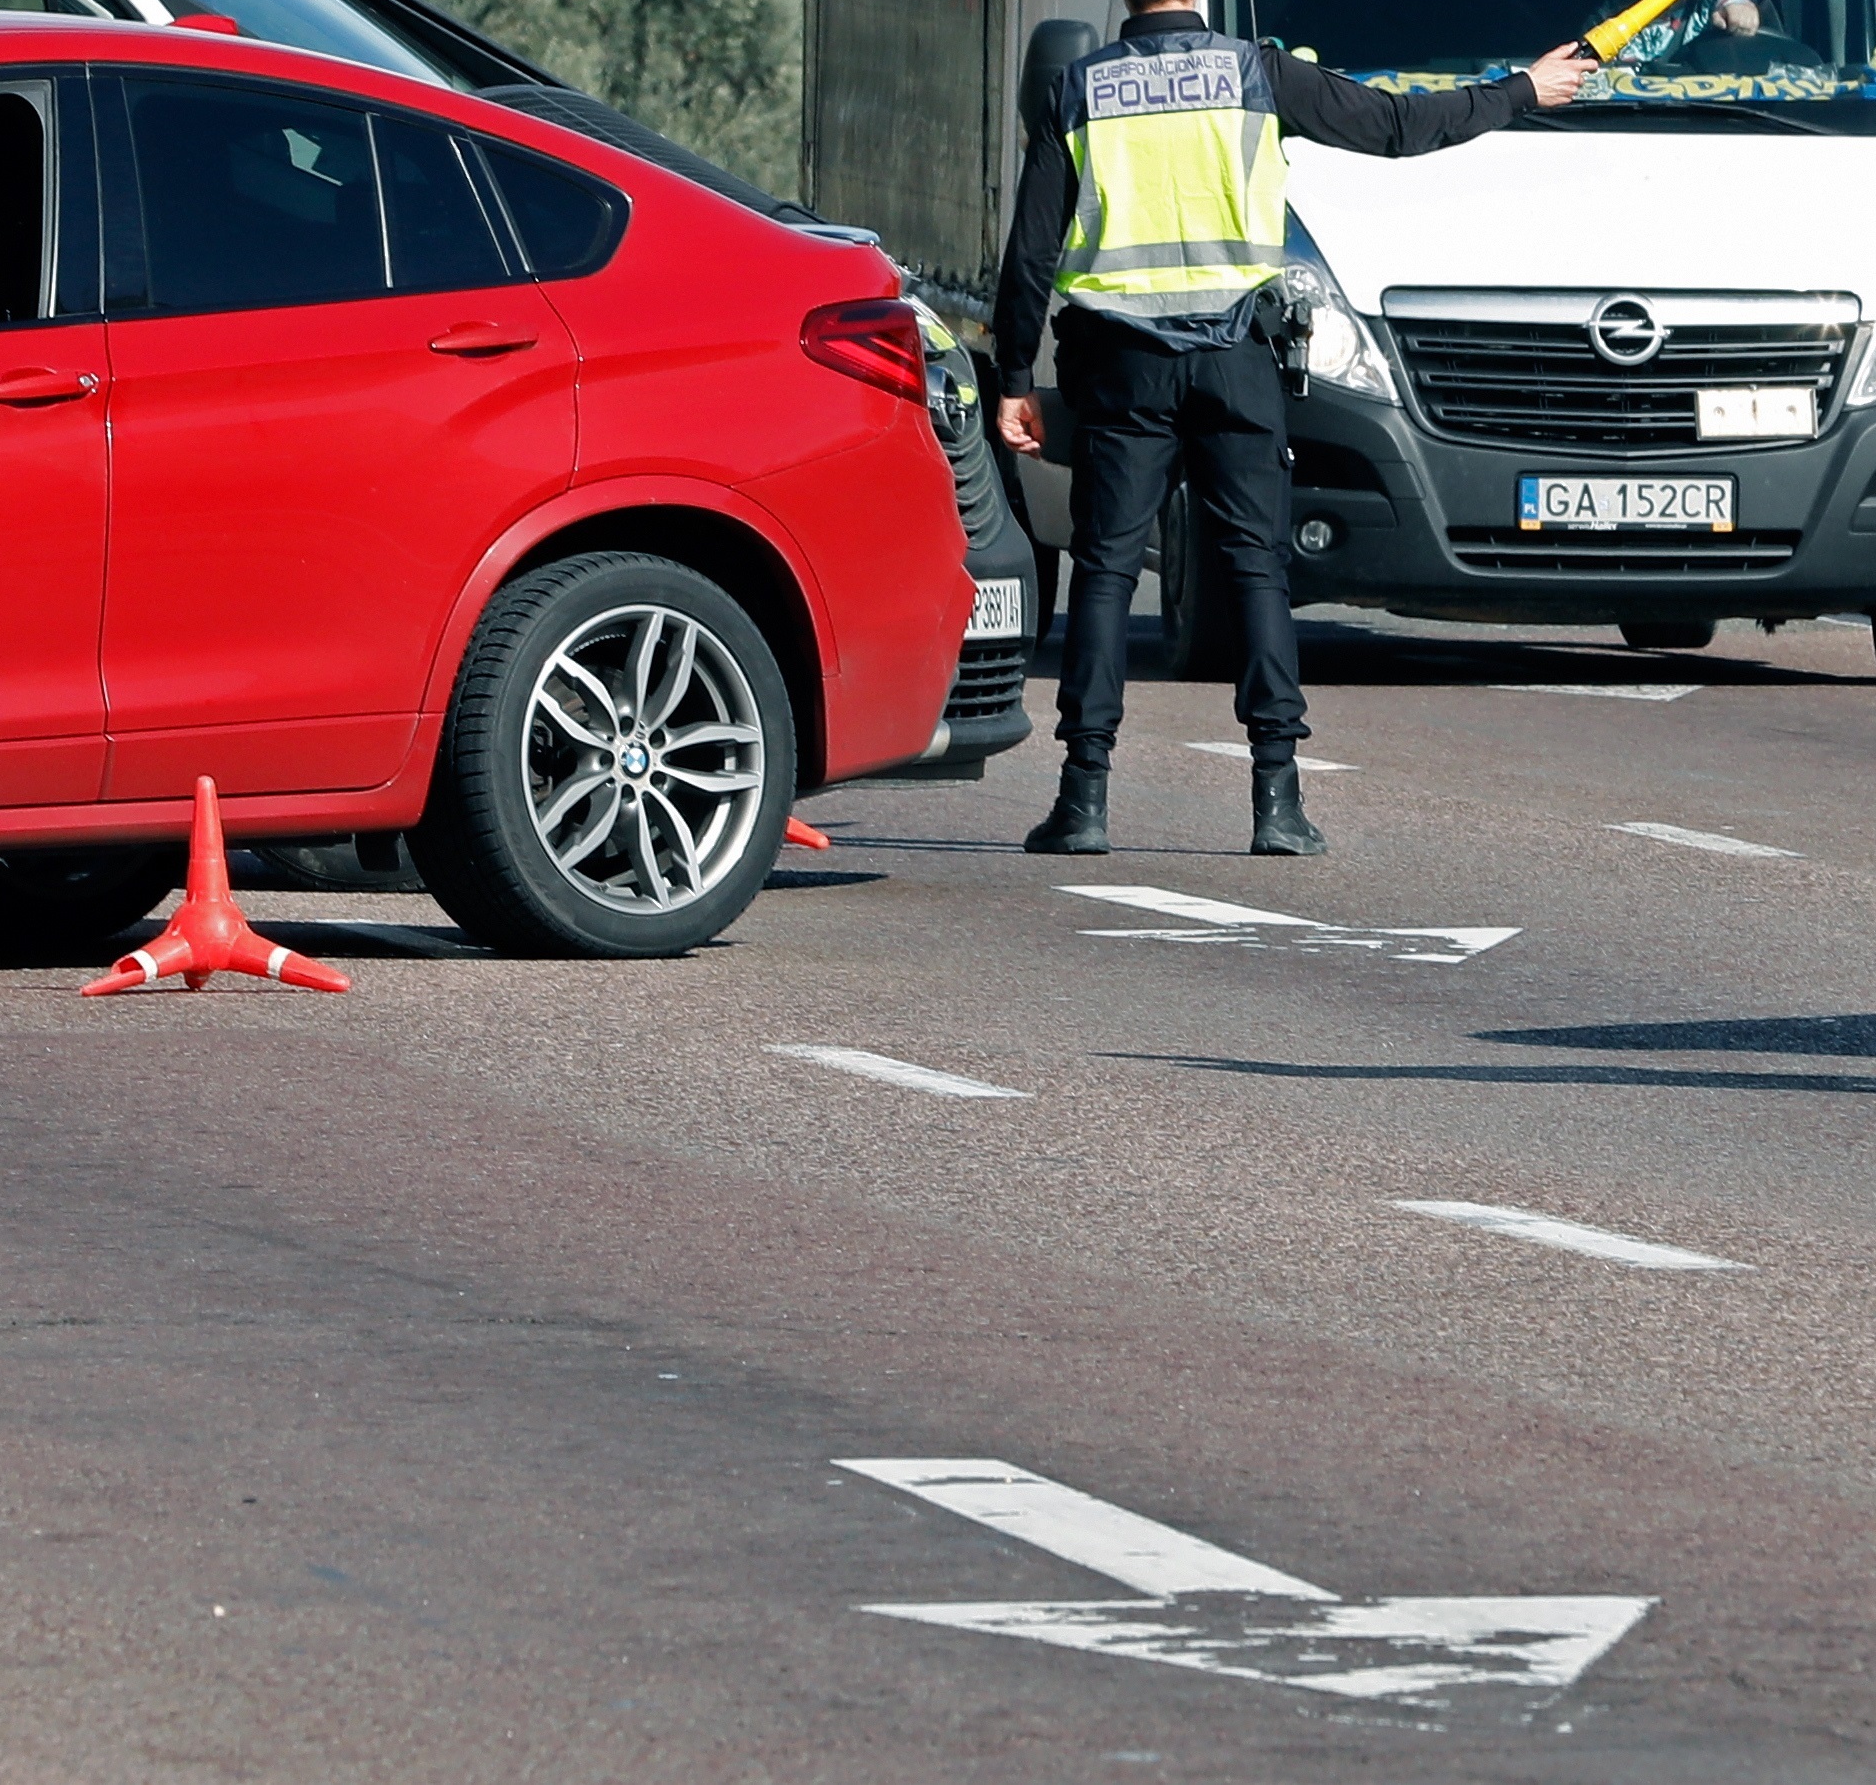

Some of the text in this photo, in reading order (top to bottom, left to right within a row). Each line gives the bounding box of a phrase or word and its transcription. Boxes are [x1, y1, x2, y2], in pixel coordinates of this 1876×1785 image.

[1092, 55, 1234, 83] CUERPO NACIONAL DE
[1093, 73, 1235, 111] POLICIA
[1525, 482, 1727, 519] PL GA 152CR
